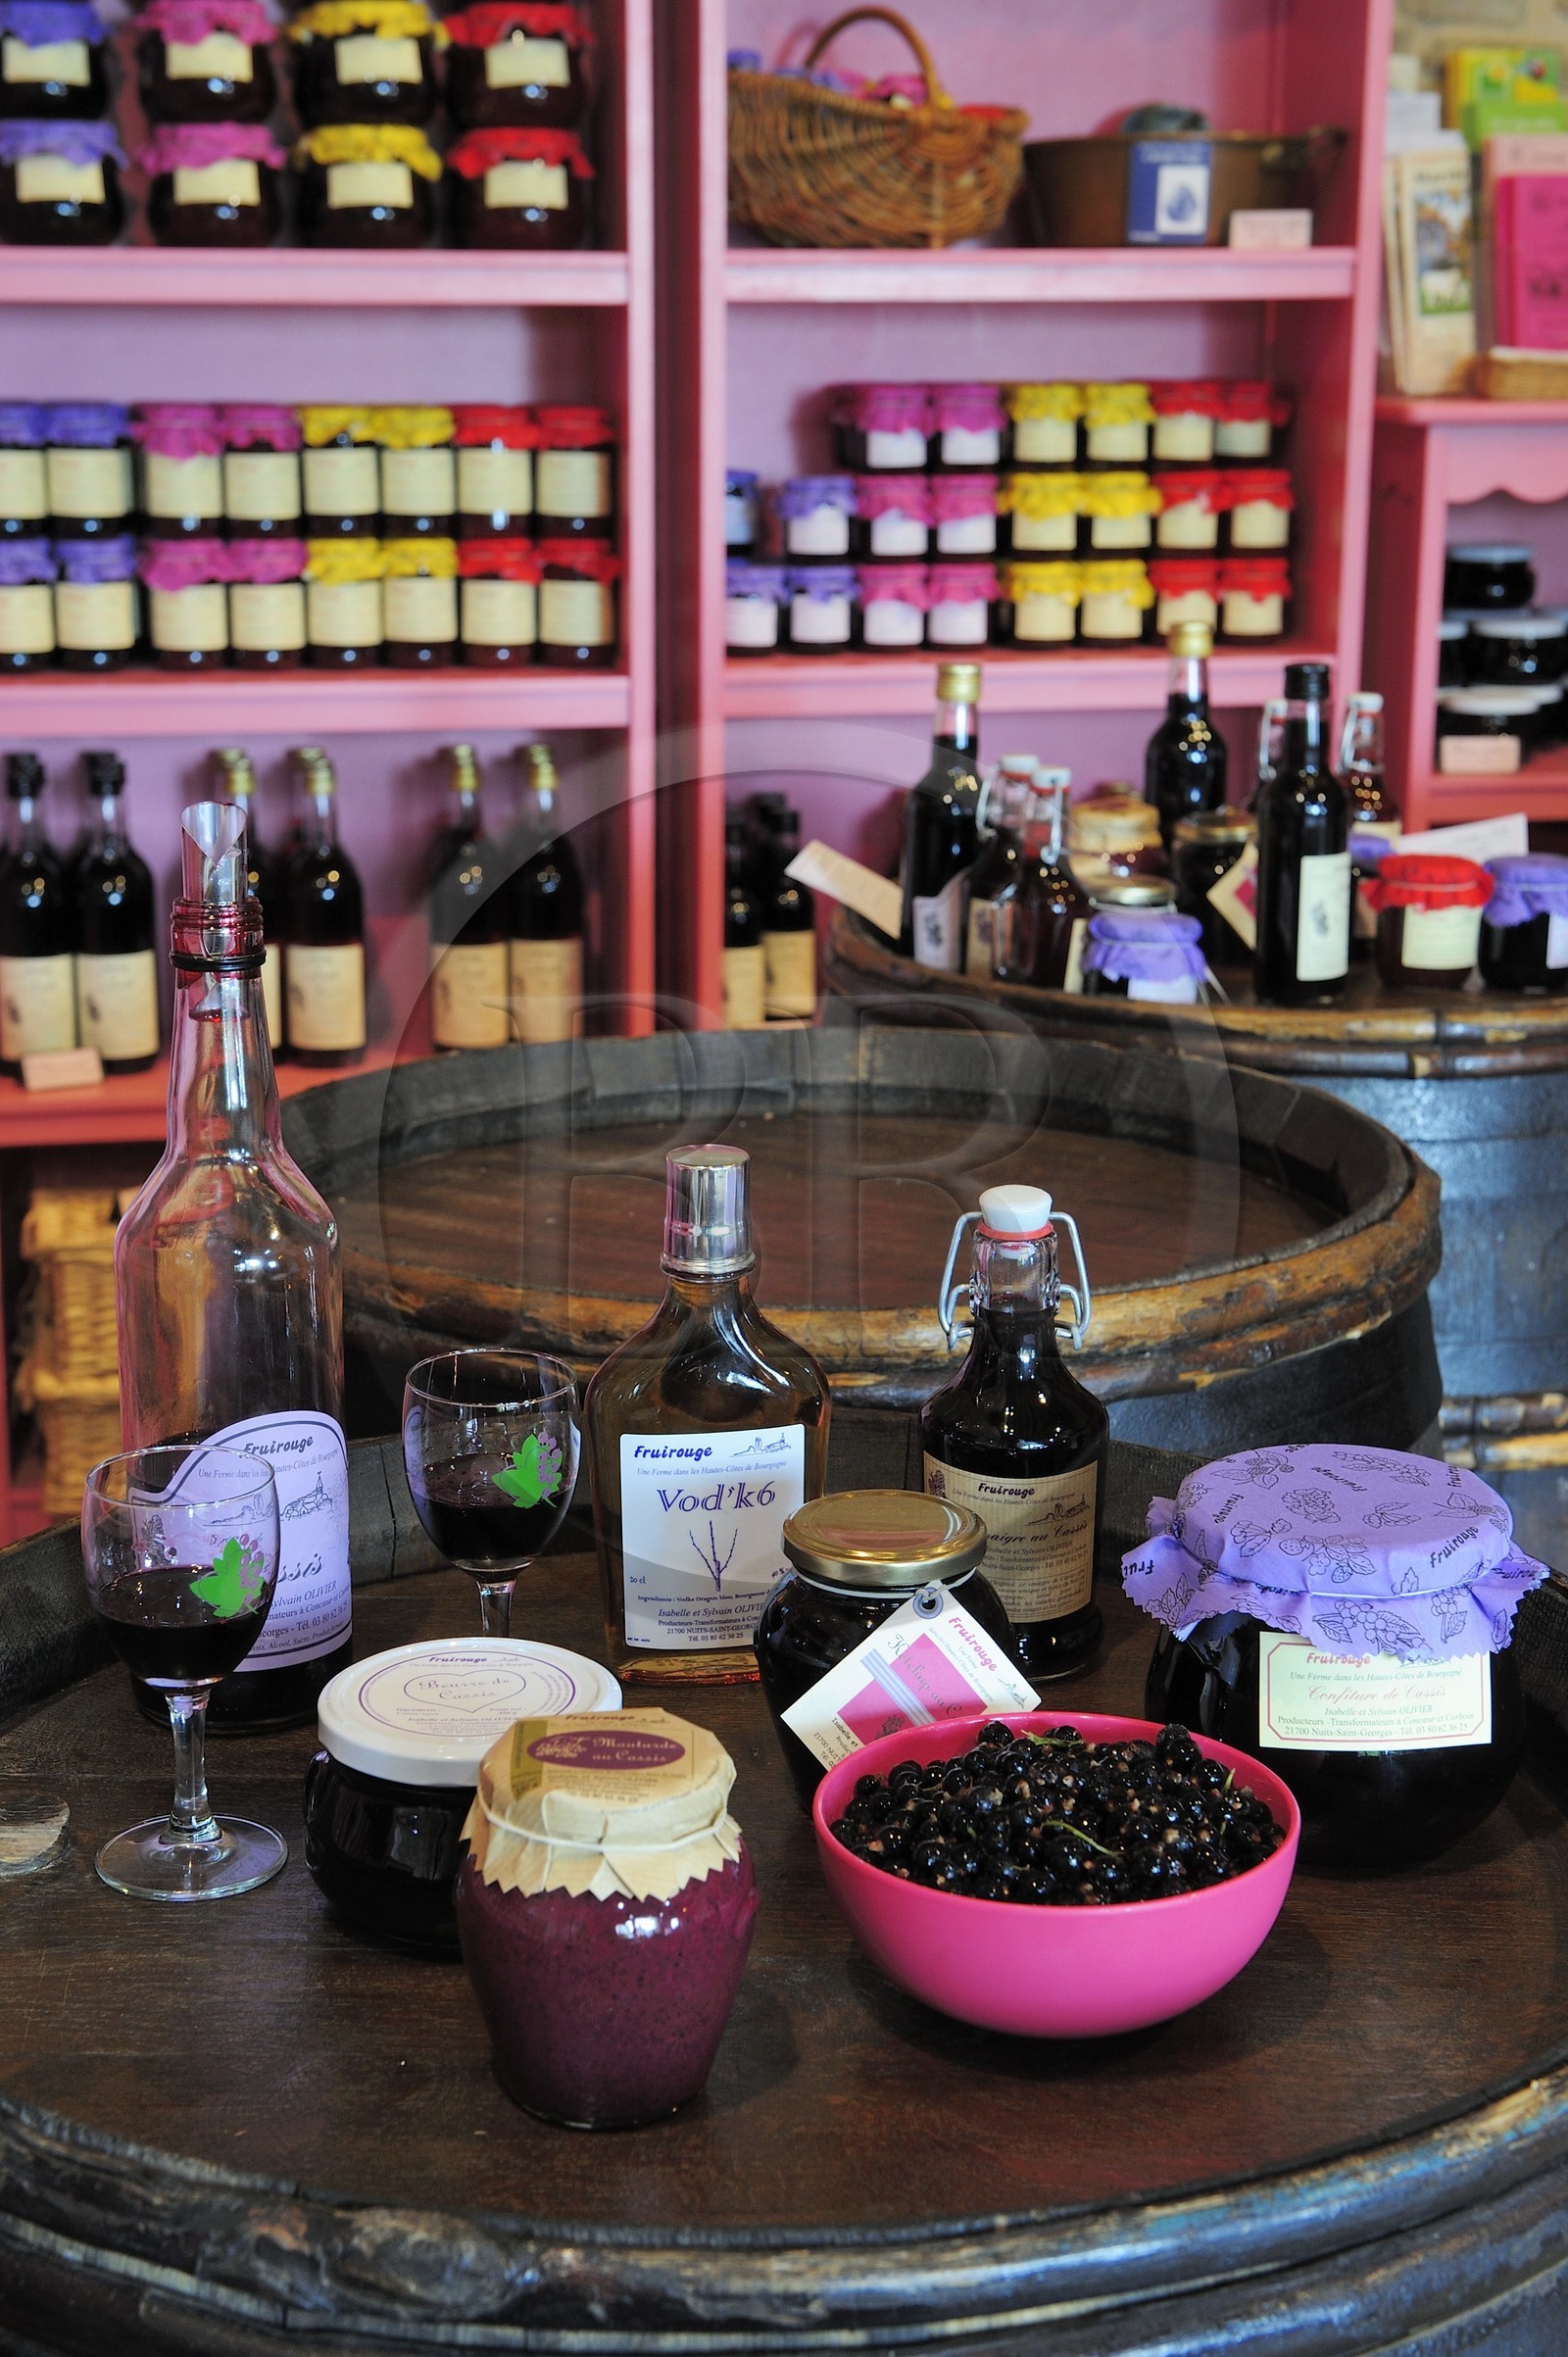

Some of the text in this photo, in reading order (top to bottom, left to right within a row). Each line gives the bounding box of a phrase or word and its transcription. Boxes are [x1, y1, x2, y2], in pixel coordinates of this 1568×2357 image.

[241, 1436, 313, 1456] Fruirouge
[634, 1446, 712, 1461] Fruirouge
[236, 1469, 251, 1478] dans
[702, 1464, 743, 1474] Hautes-Côtes
[755, 1460, 787, 1471] Bourgogne
[1311, 1466, 1368, 1493] Fruirouge
[978, 1483, 1035, 1498] Fruirouge
[1212, 1494, 1245, 1524] Fruirouge
[1031, 1533, 1049, 1542] au
[1054, 1521, 1088, 1538] Cassis
[1021, 1547, 1046, 1555] Sylvain
[1430, 1526, 1479, 1568] Fruirouge
[277, 1553, 322, 1583] ssis
[305, 1580, 337, 1600] OLIVIER
[703, 1608, 732, 1618] Sylvain
[313, 1617, 320, 1626] 03
[659, 1617, 741, 1626] Producteurs-Transformateurs
[268, 1640, 292, 1650] Alcool,
[949, 1617, 997, 1671] Fruirouge
[1306, 1652, 1371, 1668] Fruirouge
[888, 1634, 945, 1707] Ketchup au
[1367, 1671, 1415, 1681] Hautes-Côtes
[1427, 1669, 1462, 1680] Bourgogne
[1383, 1687, 1397, 1700] de
[1404, 1684, 1446, 1698] Cassis
[1369, 1707, 1397, 1718] Sylvain
[1399, 1704, 1433, 1714] OLIVIER
[1278, 1716, 1324, 1726] Producteurs
[1446, 1713, 1474, 1722] Corboin
[832, 1717, 858, 1748] Isabelle et
[1285, 1727, 1309, 1736] 21700
[1312, 1727, 1393, 1738] Nuits-Saint-Georges
[1427, 1725, 1437, 1734] 80
[593, 1737, 678, 1749] Moutarde
[813, 1732, 828, 1748] 21700
[615, 1750, 667, 1762] Cassis
